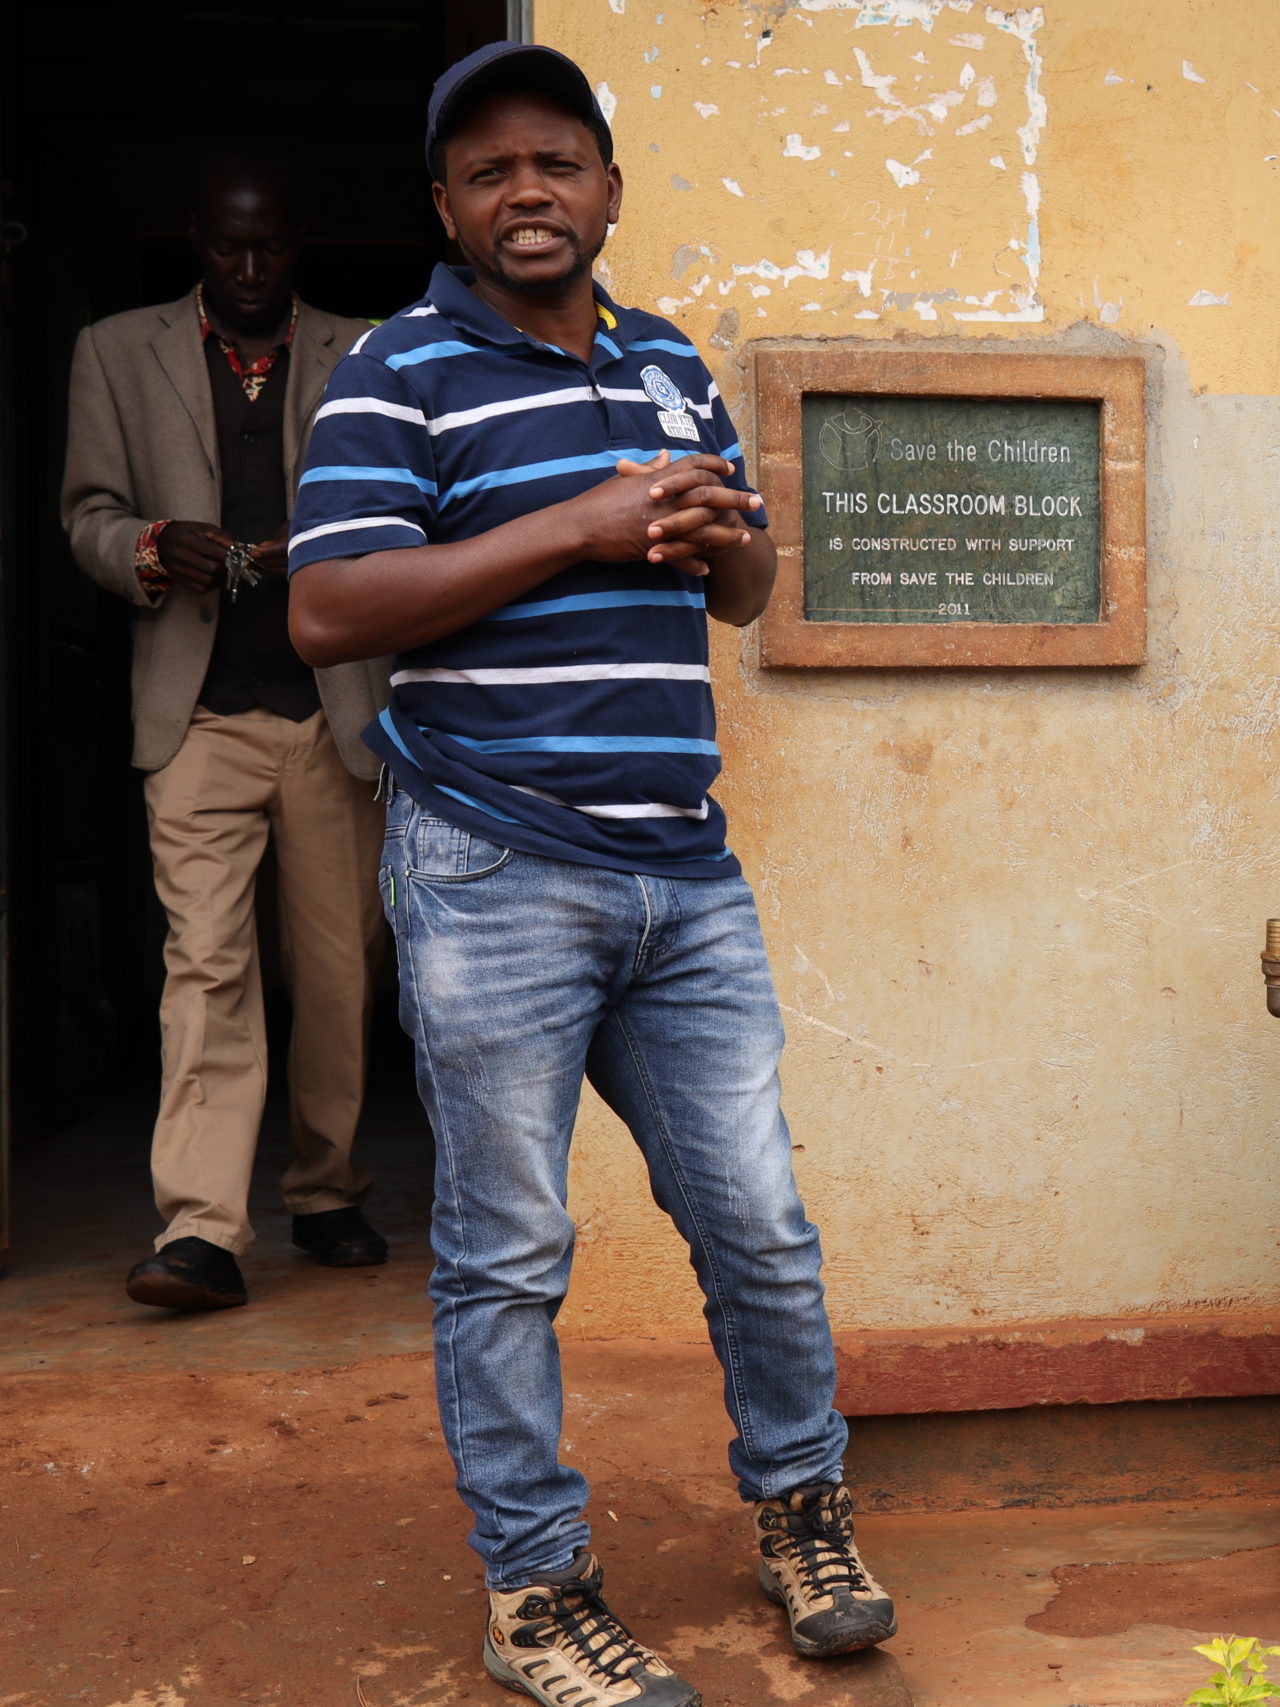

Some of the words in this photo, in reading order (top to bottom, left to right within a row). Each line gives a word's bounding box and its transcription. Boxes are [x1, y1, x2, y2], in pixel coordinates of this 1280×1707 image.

[890, 437, 937, 462] Save
[946, 438, 977, 462] the
[987, 439, 1071, 463] Children
[822, 491, 868, 514] THIS
[877, 492, 1006, 516] CLASSROOM
[1014, 494, 1083, 517] BLOCK
[829, 537, 843, 551] IS
[851, 537, 957, 551] CONSTRUCTED
[965, 538, 1001, 551] WITH
[1008, 538, 1075, 551] SUPPORT
[851, 572, 892, 586] FROM
[900, 572, 937, 586] SAVE
[945, 572, 974, 586] THE
[982, 572, 1054, 586] CHILDREN
[938, 602, 970, 616] 2011
